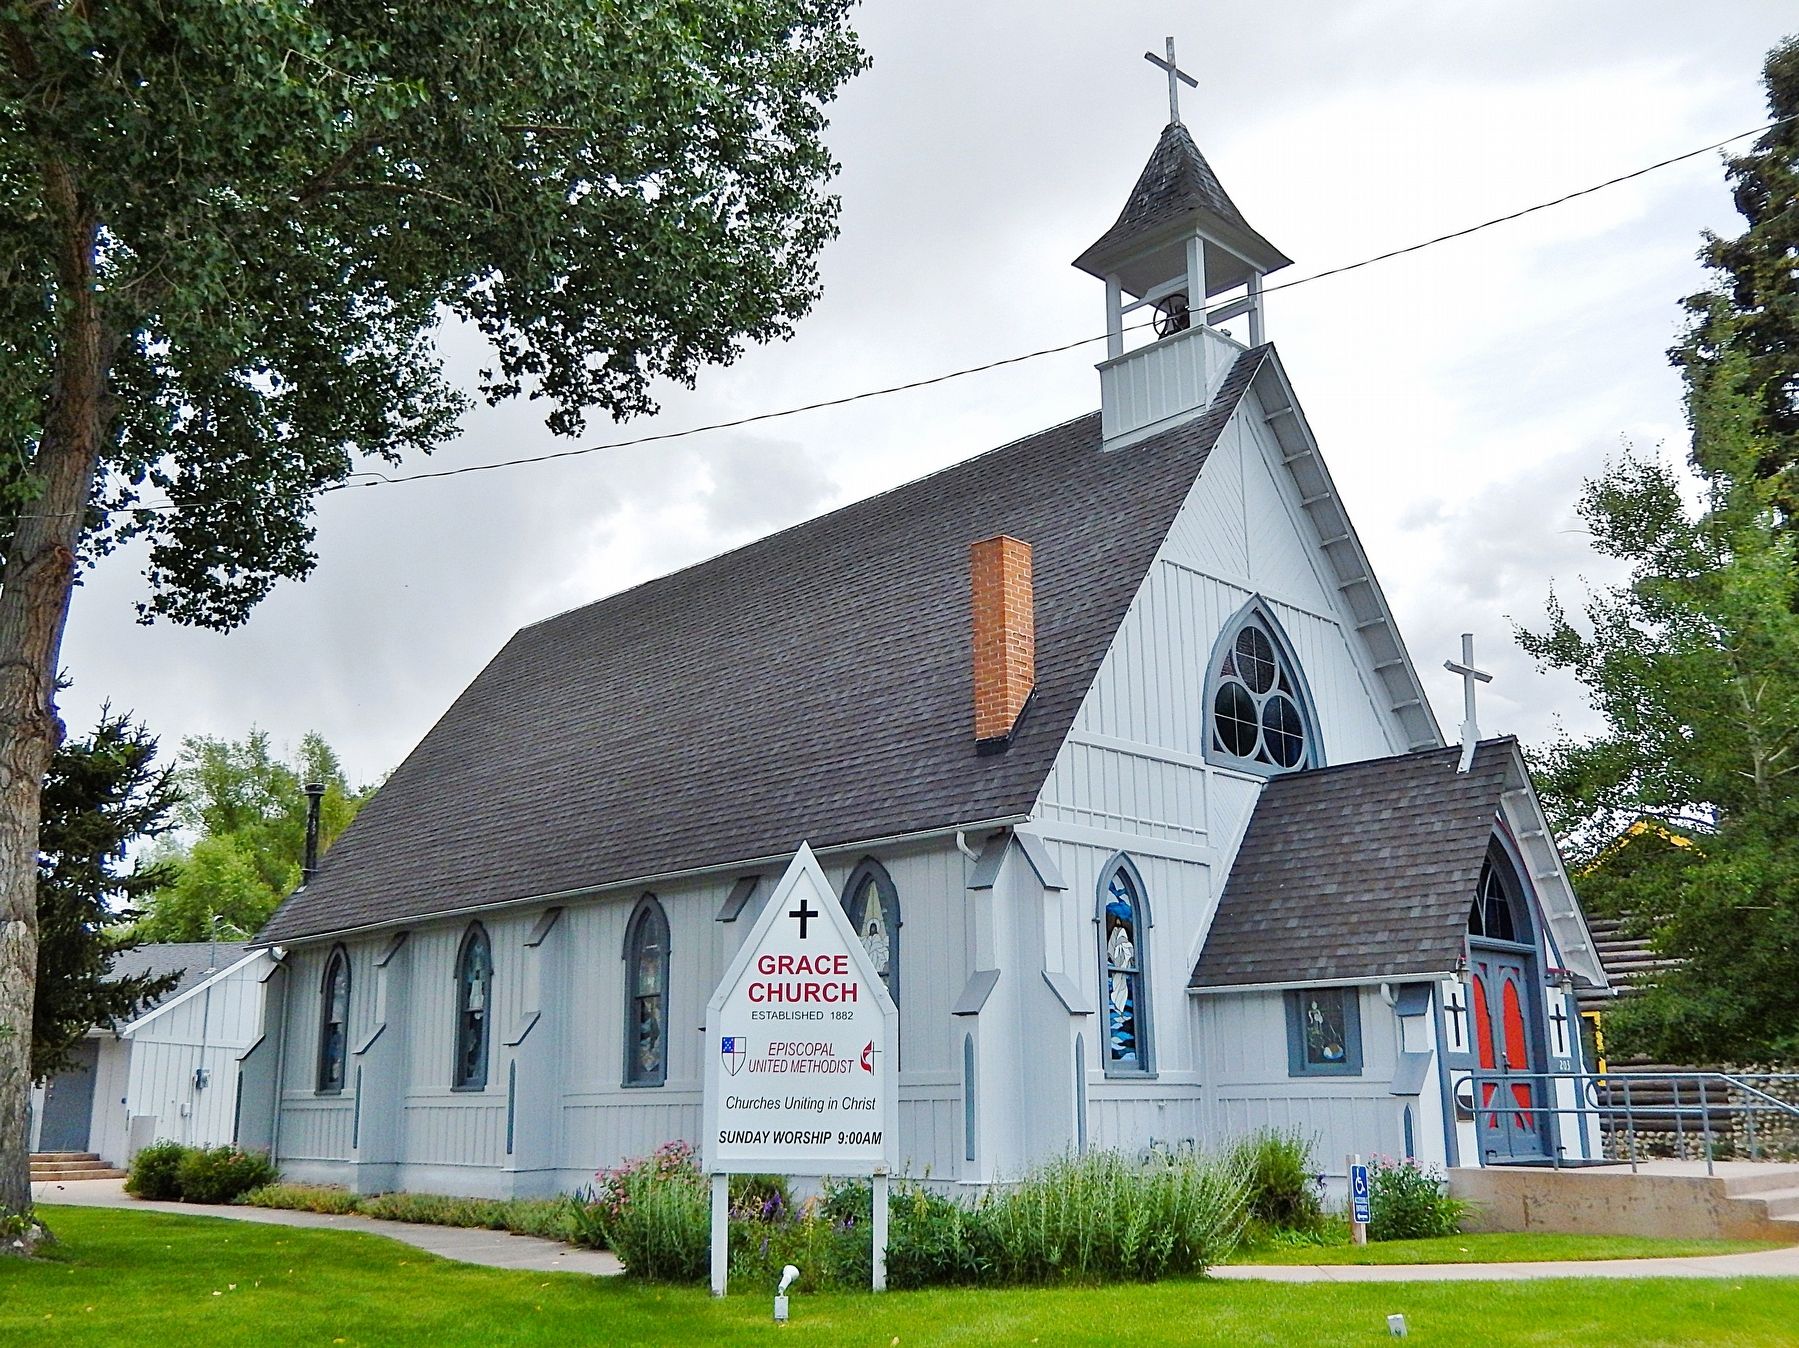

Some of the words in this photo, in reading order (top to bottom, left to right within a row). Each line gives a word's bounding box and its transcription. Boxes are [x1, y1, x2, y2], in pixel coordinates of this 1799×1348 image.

[757, 955, 849, 975] GRACE
[748, 982, 858, 1003] CHURCH
[751, 1010, 824, 1021] ESTABLISHED
[830, 1010, 854, 1021] 1882
[768, 1042, 836, 1057] EPISCOPAL
[748, 1058, 788, 1073] UNITED
[790, 1059, 855, 1074] METHODIST
[725, 1095, 781, 1110] Churches
[784, 1095, 825, 1114] Uniting
[827, 1095, 838, 1110] in
[841, 1096, 876, 1111] Christ
[718, 1130, 771, 1144] SUNDAY
[773, 1130, 832, 1145] WORSHIP
[837, 1131, 883, 1145] 9:00AM
